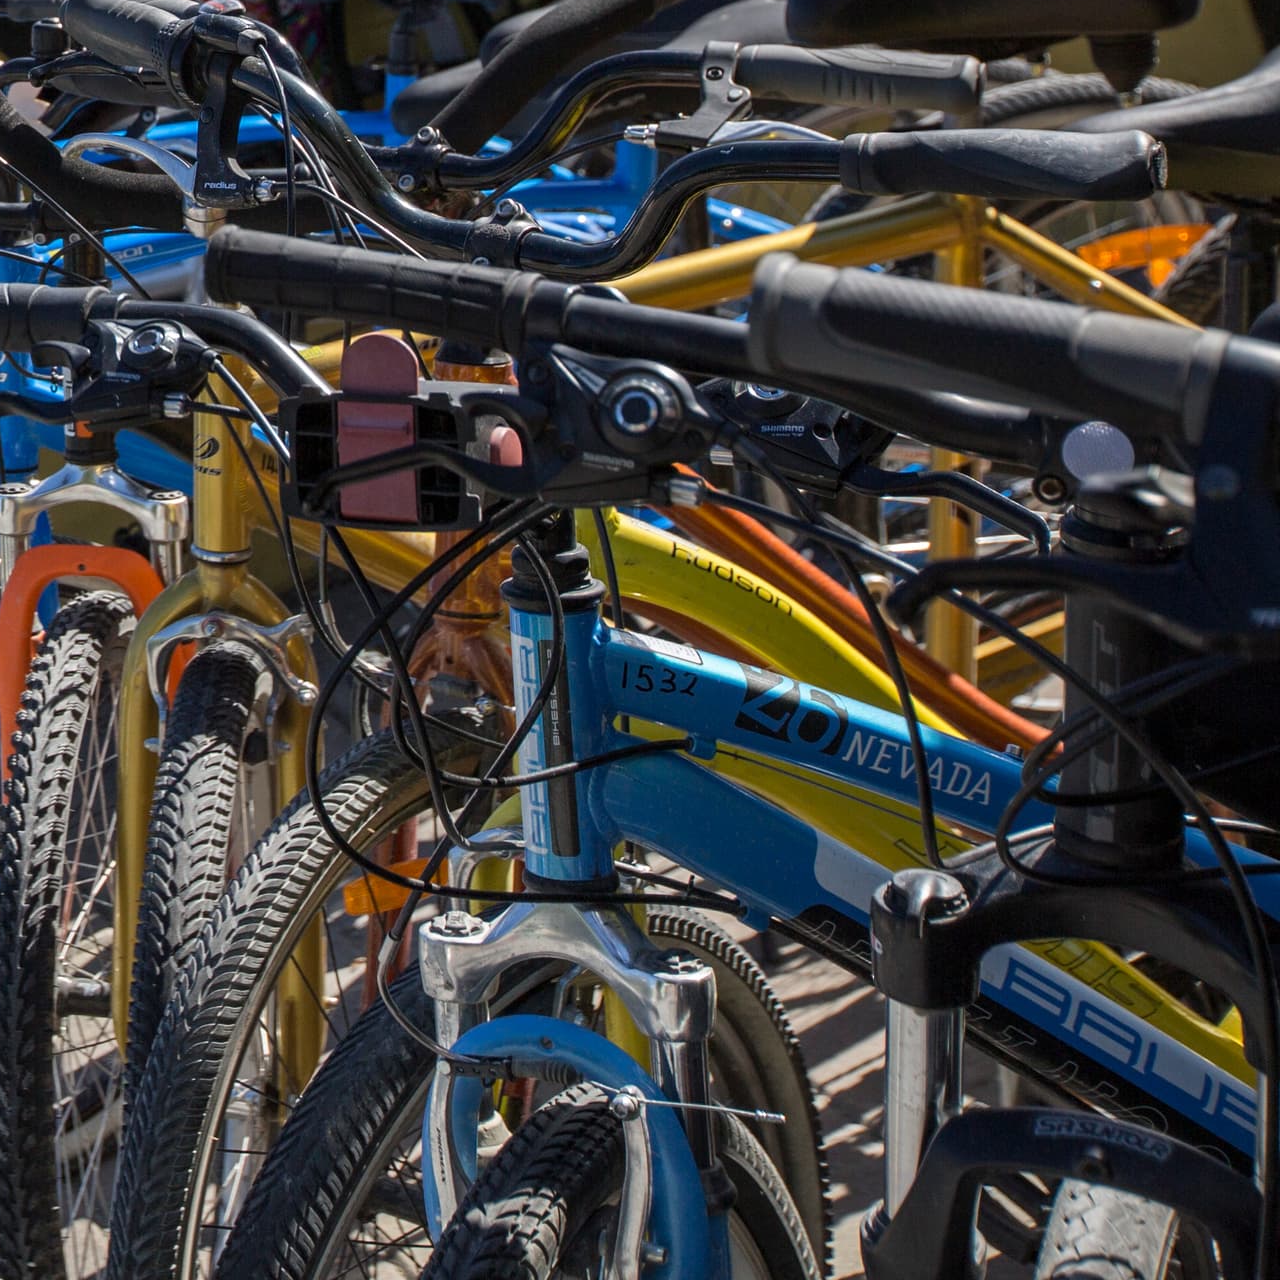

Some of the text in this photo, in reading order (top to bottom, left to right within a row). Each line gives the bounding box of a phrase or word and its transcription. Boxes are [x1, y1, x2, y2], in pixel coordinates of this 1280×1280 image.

[203, 181, 237, 190] radius
[761, 423, 806, 433] SHIMANO
[670, 540, 794, 618] hudson
[620, 661, 700, 698] 1532
[739, 664, 992, 807] 26 NEVADA
[1000, 957, 1259, 1133] BAUE
